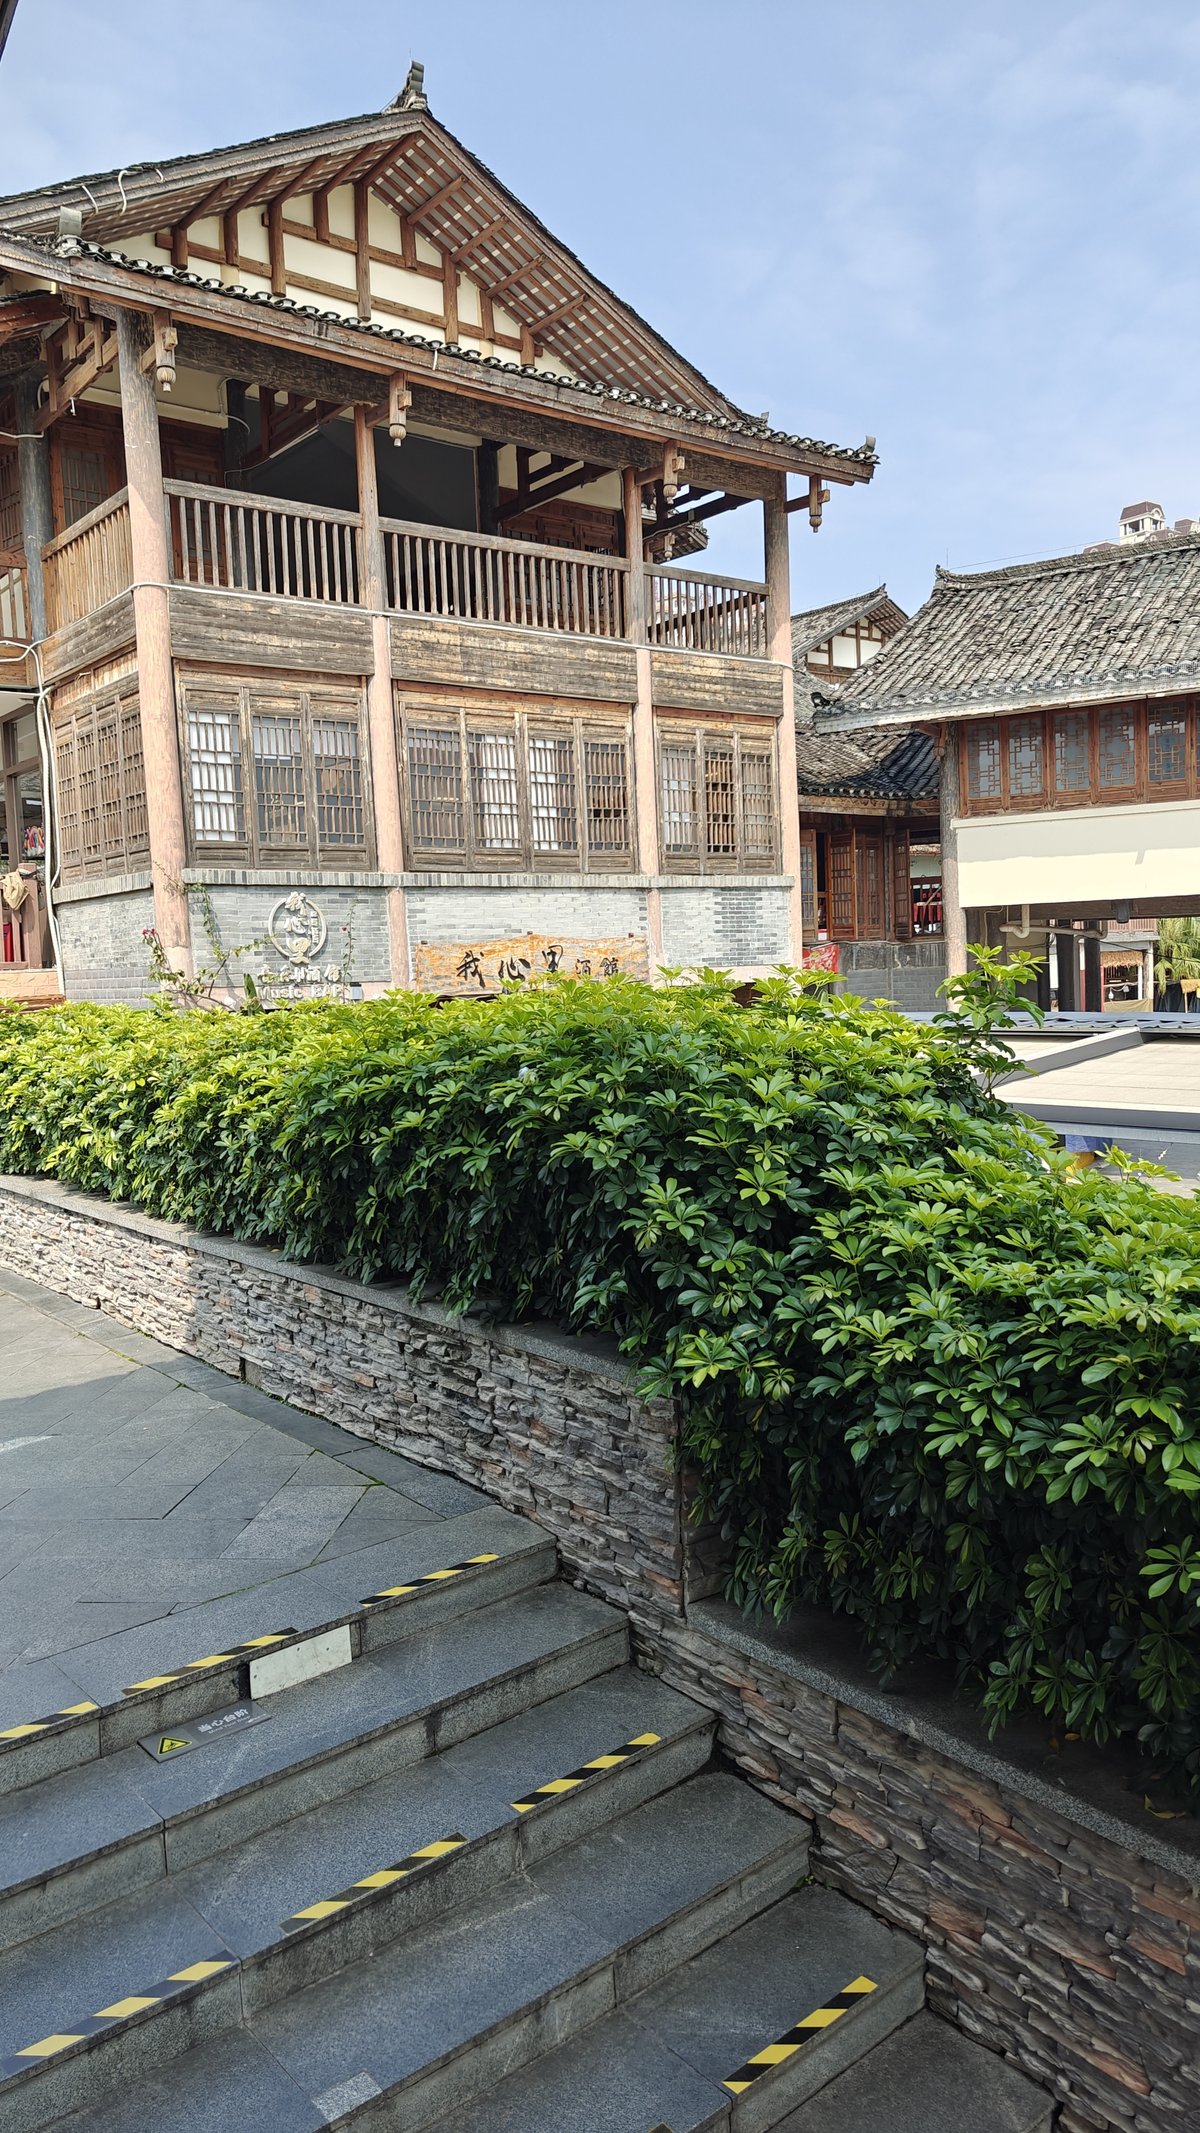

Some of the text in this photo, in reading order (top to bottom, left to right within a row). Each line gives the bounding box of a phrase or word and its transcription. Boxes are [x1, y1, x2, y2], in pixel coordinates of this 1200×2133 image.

[256, 985, 303, 999] Music
[197, 1708, 249, 1733] 当心台阶
